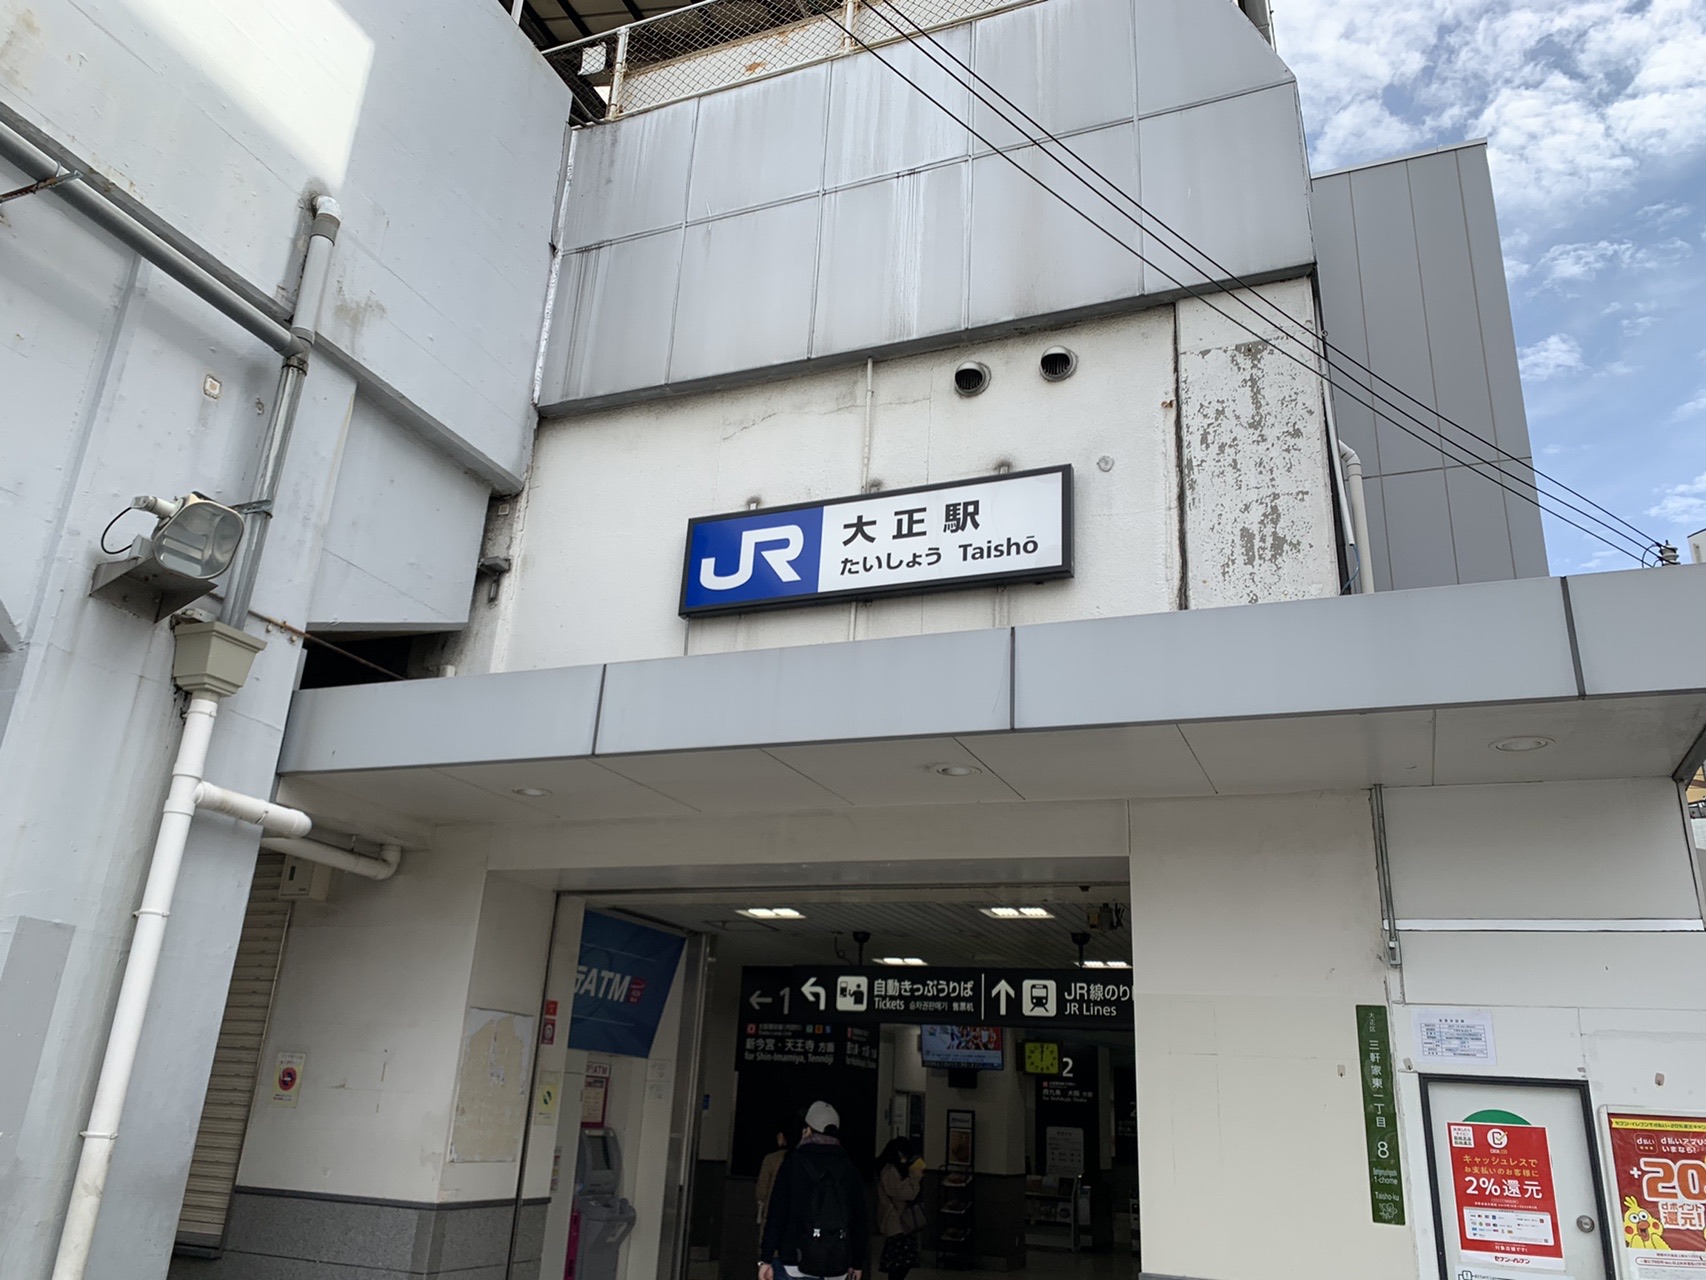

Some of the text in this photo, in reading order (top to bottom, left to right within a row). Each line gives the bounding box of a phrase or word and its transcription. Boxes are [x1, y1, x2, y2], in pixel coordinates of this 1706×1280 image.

[841, 500, 981, 547] 大正駅
[699, 524, 804, 591] JR
[840, 534, 1039, 577] たいしょう Taishō
[873, 979, 975, 998] 自動きっぷうりば
[1064, 982, 1135, 1002] JR線のり
[779, 987, 791, 1015] 1
[874, 998, 905, 1011] Tickets
[1064, 1002, 1117, 1017] JR Lines
[1062, 1057, 1074, 1078] 2
[1369, 1039, 1386, 1128] 三軒家東一丁目
[1376, 1141, 1390, 1159] 8
[1636, 1137, 1655, 1145] d払い
[1463, 1154, 1539, 1168] キャッシュレスで
[1373, 1175, 1398, 1186] 1-chome
[1464, 1166, 1540, 1177] お支払いのお客様に
[1375, 1191, 1400, 1202] Taisho-ku
[1464, 1176, 1543, 1200] 2%還元
[1661, 1202, 1702, 1212] dポイント
